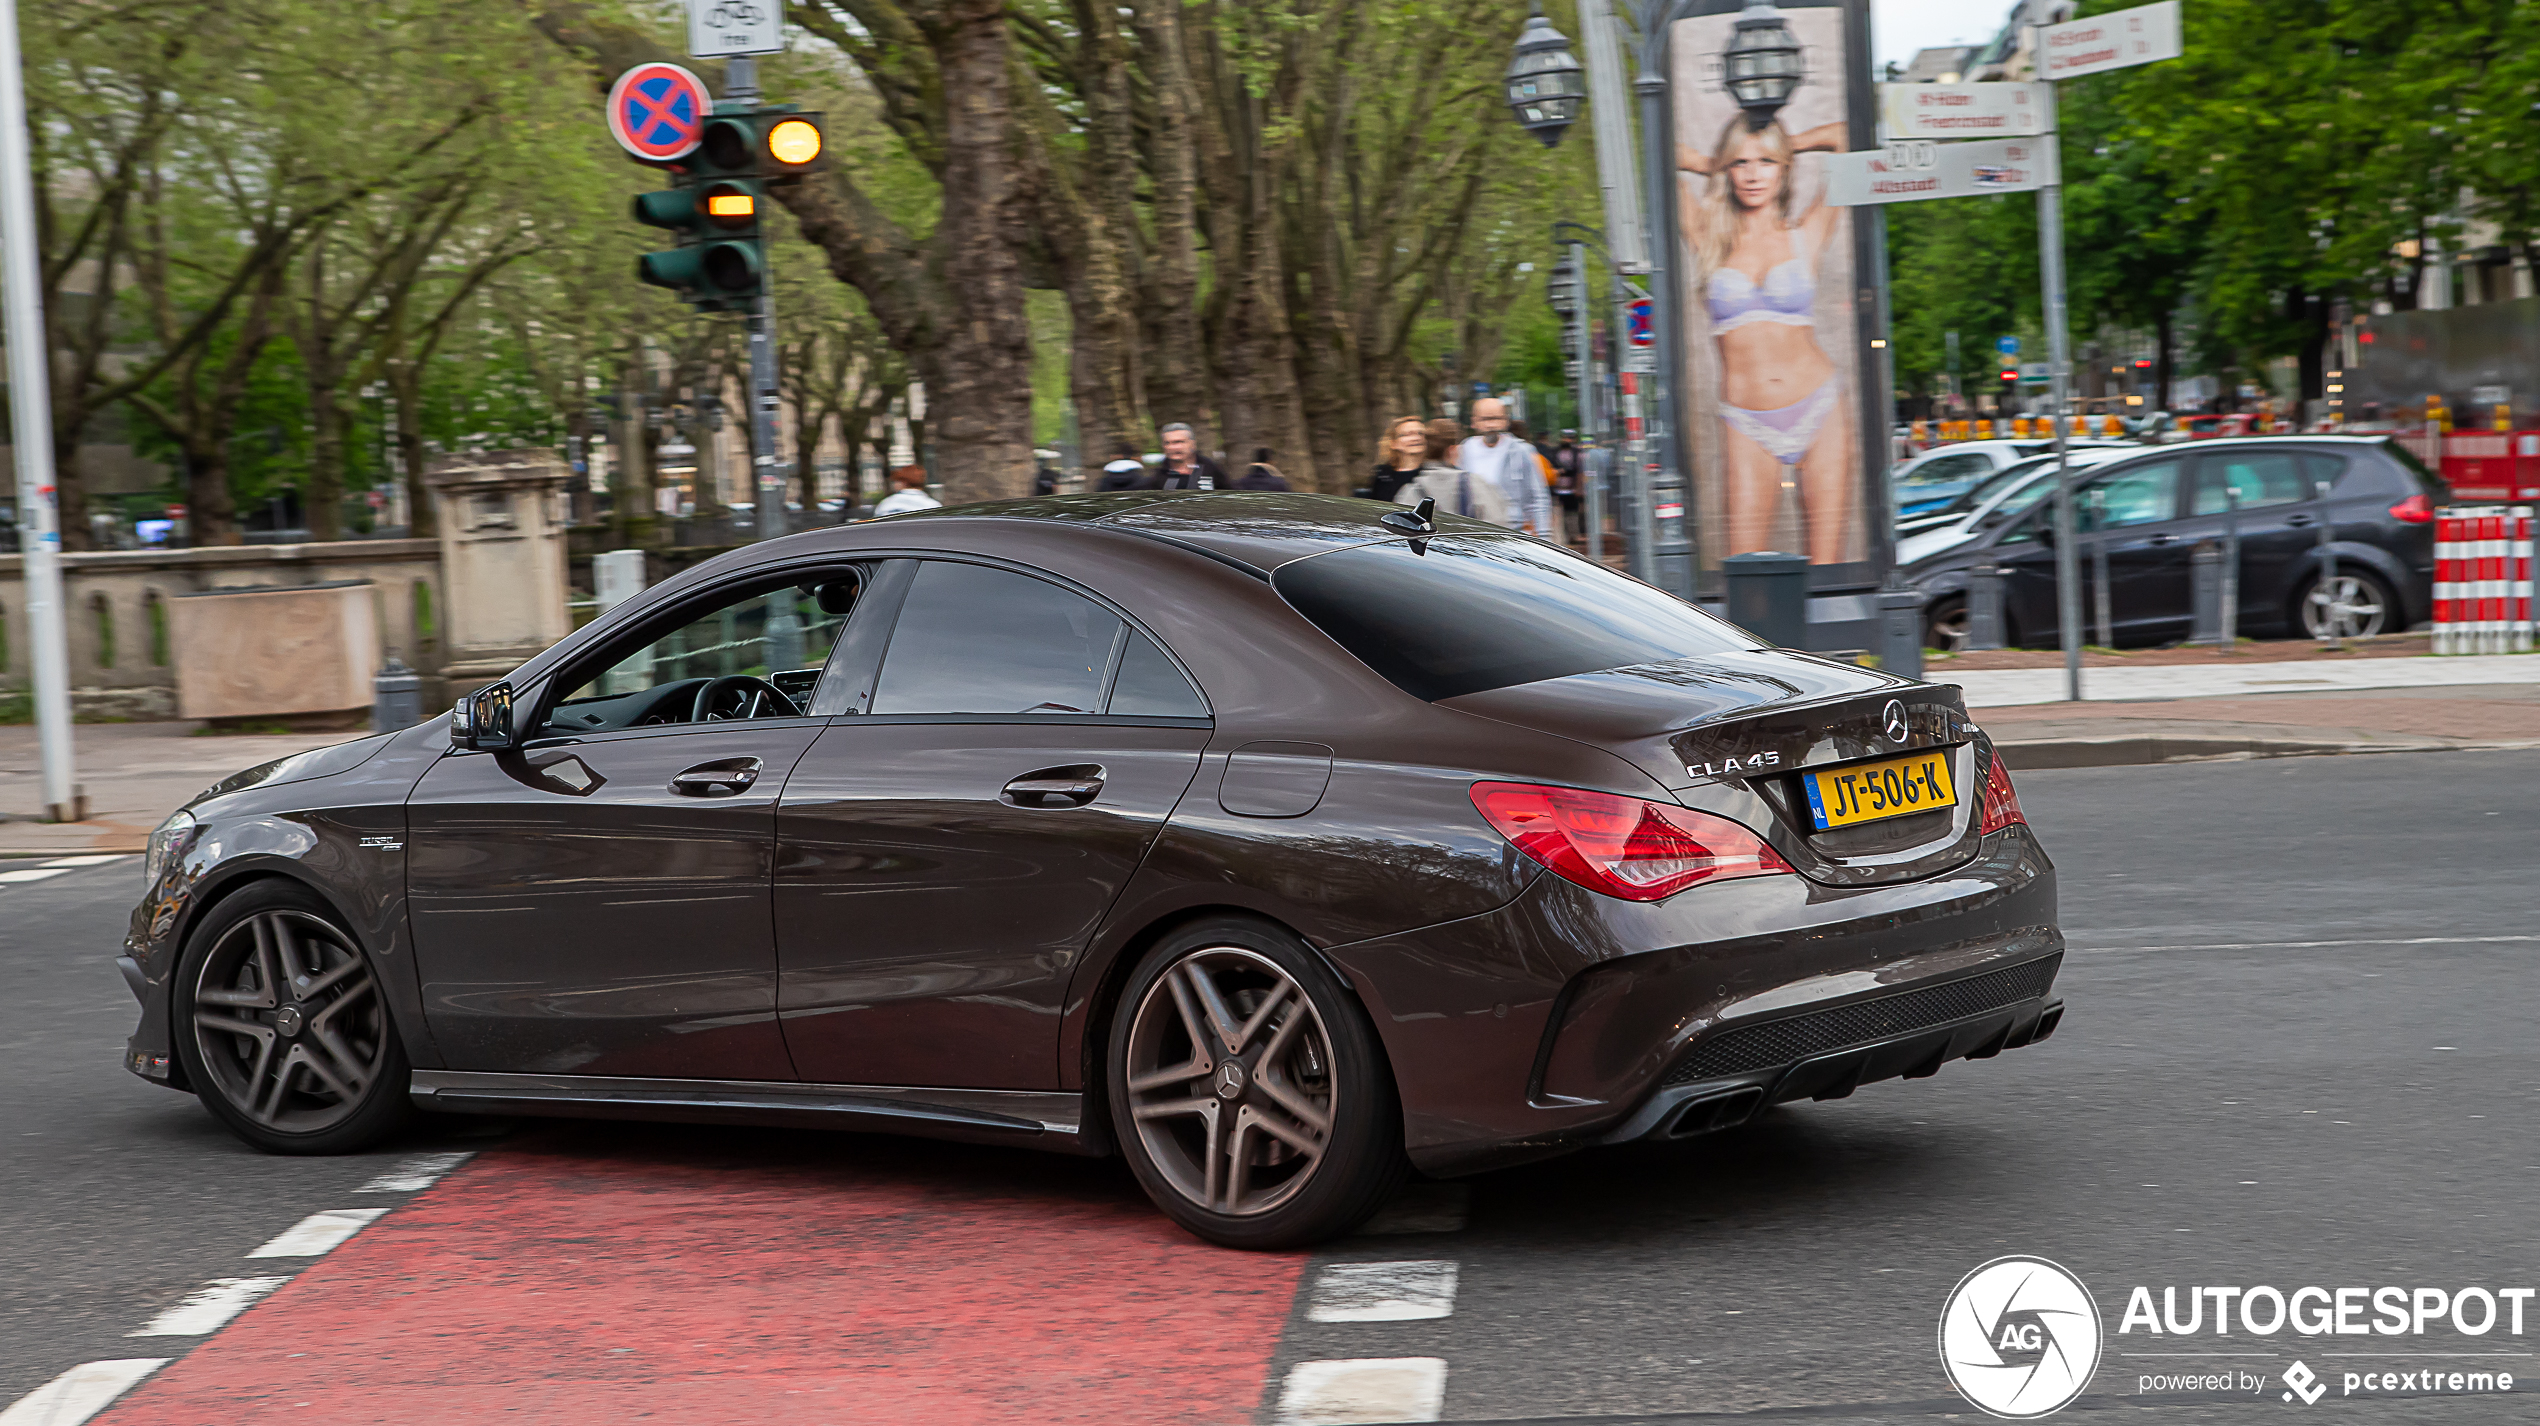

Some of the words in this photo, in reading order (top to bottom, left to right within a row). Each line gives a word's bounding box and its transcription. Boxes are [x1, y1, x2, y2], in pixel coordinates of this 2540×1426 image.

[1686, 758, 1743, 778] CLA
[1747, 751, 1780, 767] 45
[1833, 762, 1946, 817] JT-506-K
[1812, 807, 1825, 820] NL
